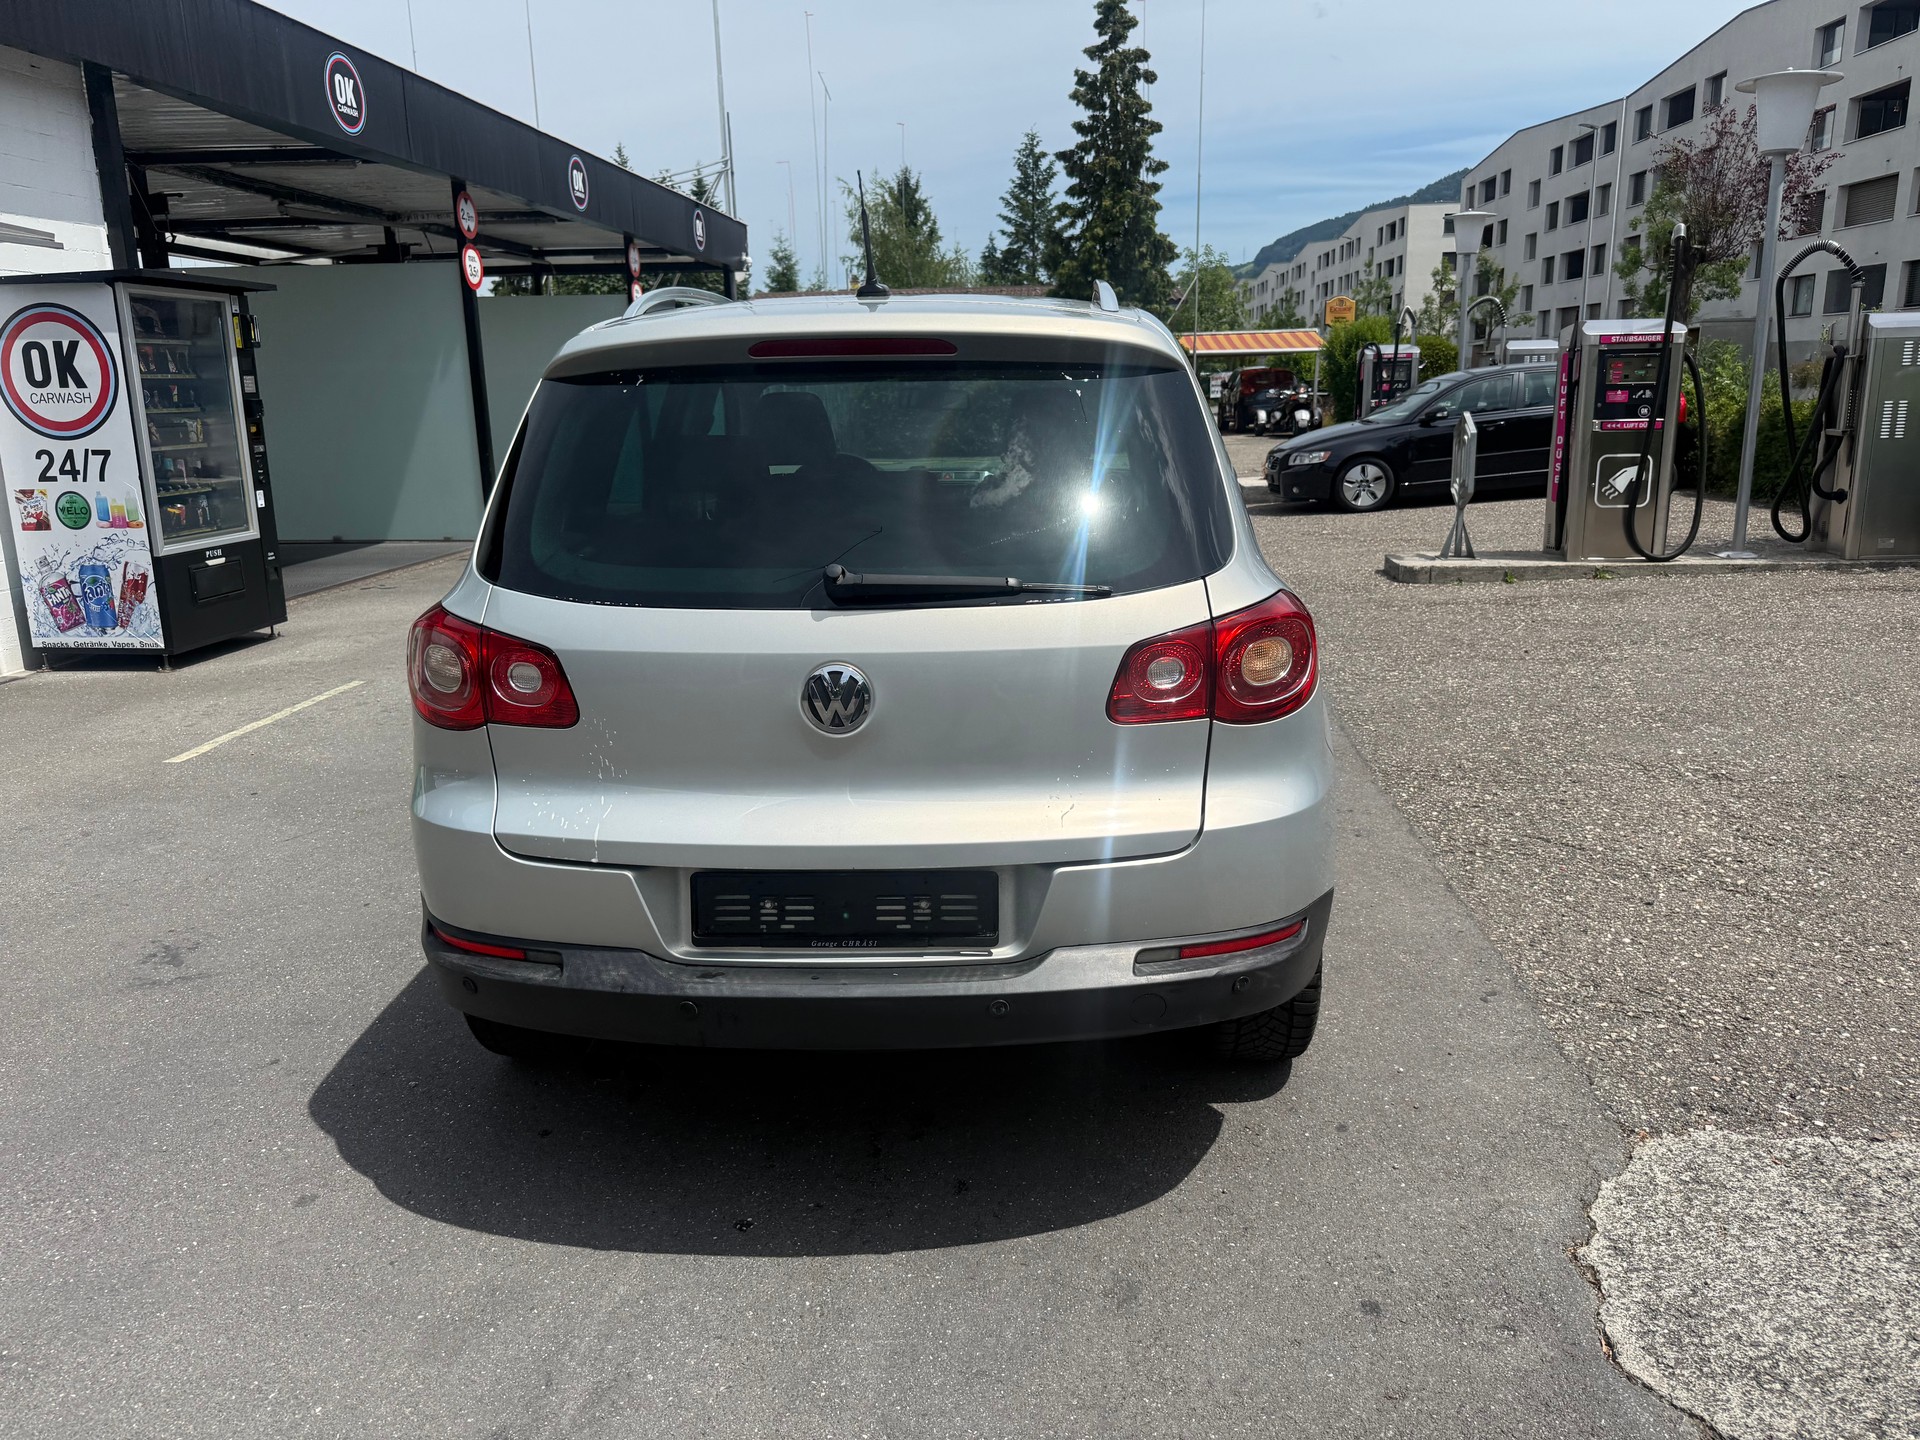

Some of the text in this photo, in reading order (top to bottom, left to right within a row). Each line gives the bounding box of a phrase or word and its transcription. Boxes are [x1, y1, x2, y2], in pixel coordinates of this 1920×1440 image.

[334, 73, 357, 108] OK
[337, 104, 358, 117] CARWASH
[573, 169, 584, 192] OK
[1611, 335, 1662, 343] STAUBSAUGER
[22, 340, 88, 389] OK
[30, 392, 92, 404] CARWASH
[1559, 373, 1567, 419] LUFT
[35, 448, 111, 482] 24/7
[58, 506, 89, 515] VELO
[205, 549, 222, 558] PUSH
[46, 588, 71, 606] FANTA
[42, 641, 71, 649] Snacks,
[73, 641, 110, 649] Getränke,
[111, 641, 138, 649] Vapes,
[811, 940, 838, 948] Garage
